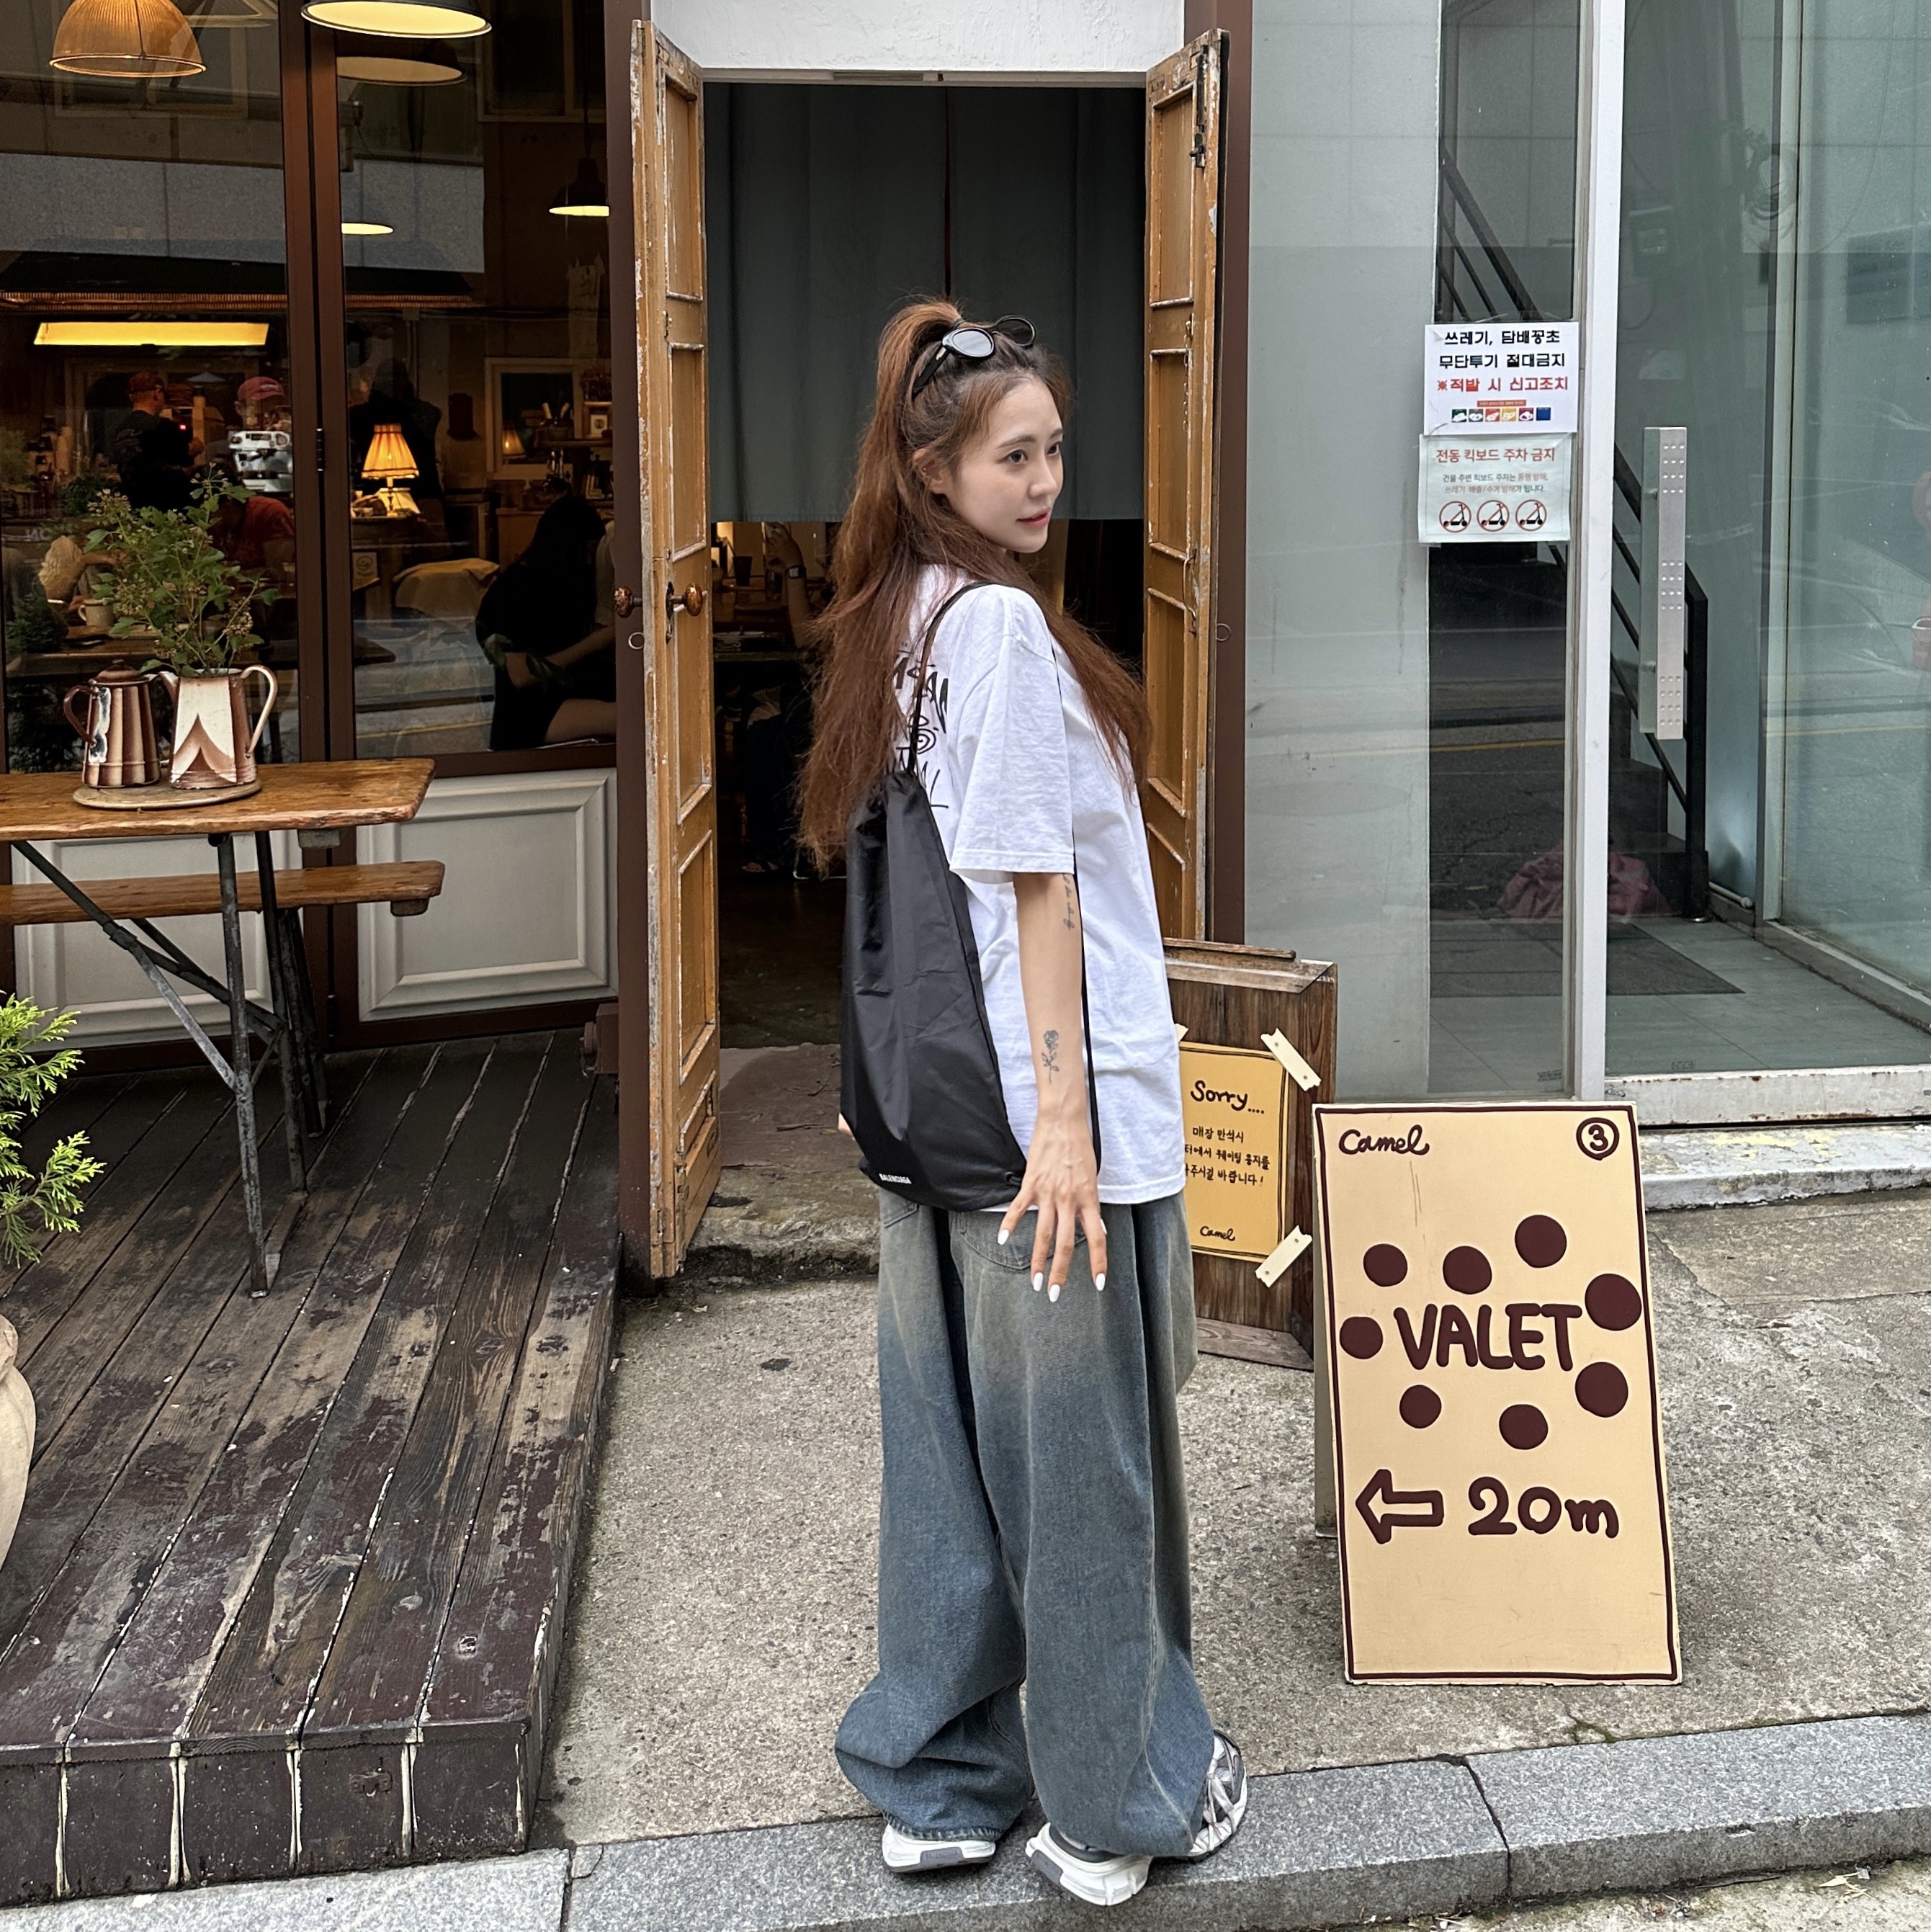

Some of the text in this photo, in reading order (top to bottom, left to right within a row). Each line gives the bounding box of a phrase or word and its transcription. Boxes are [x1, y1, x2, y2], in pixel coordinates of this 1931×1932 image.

[1444, 330, 1560, 346] 쓰레기, 담배꽁초
[1439, 353, 1565, 369] 무단투기 절대금지
[1488, 377, 1501, 391] 시
[1510, 376, 1568, 391] 신고조치
[1436, 447, 1556, 462] 전동 킥보드 주차 금지
[1443, 474, 1456, 483] 건물
[1193, 1126, 1245, 1143] 매장 만석시
[1339, 1124, 1430, 1155] Camel
[1216, 1149, 1242, 1164] 웨이팅
[1245, 1153, 1270, 1170] 용지를
[1200, 1225, 1235, 1241] Camel
[1393, 1302, 1583, 1372] VALET
[1468, 1476, 1619, 1539] 20m
